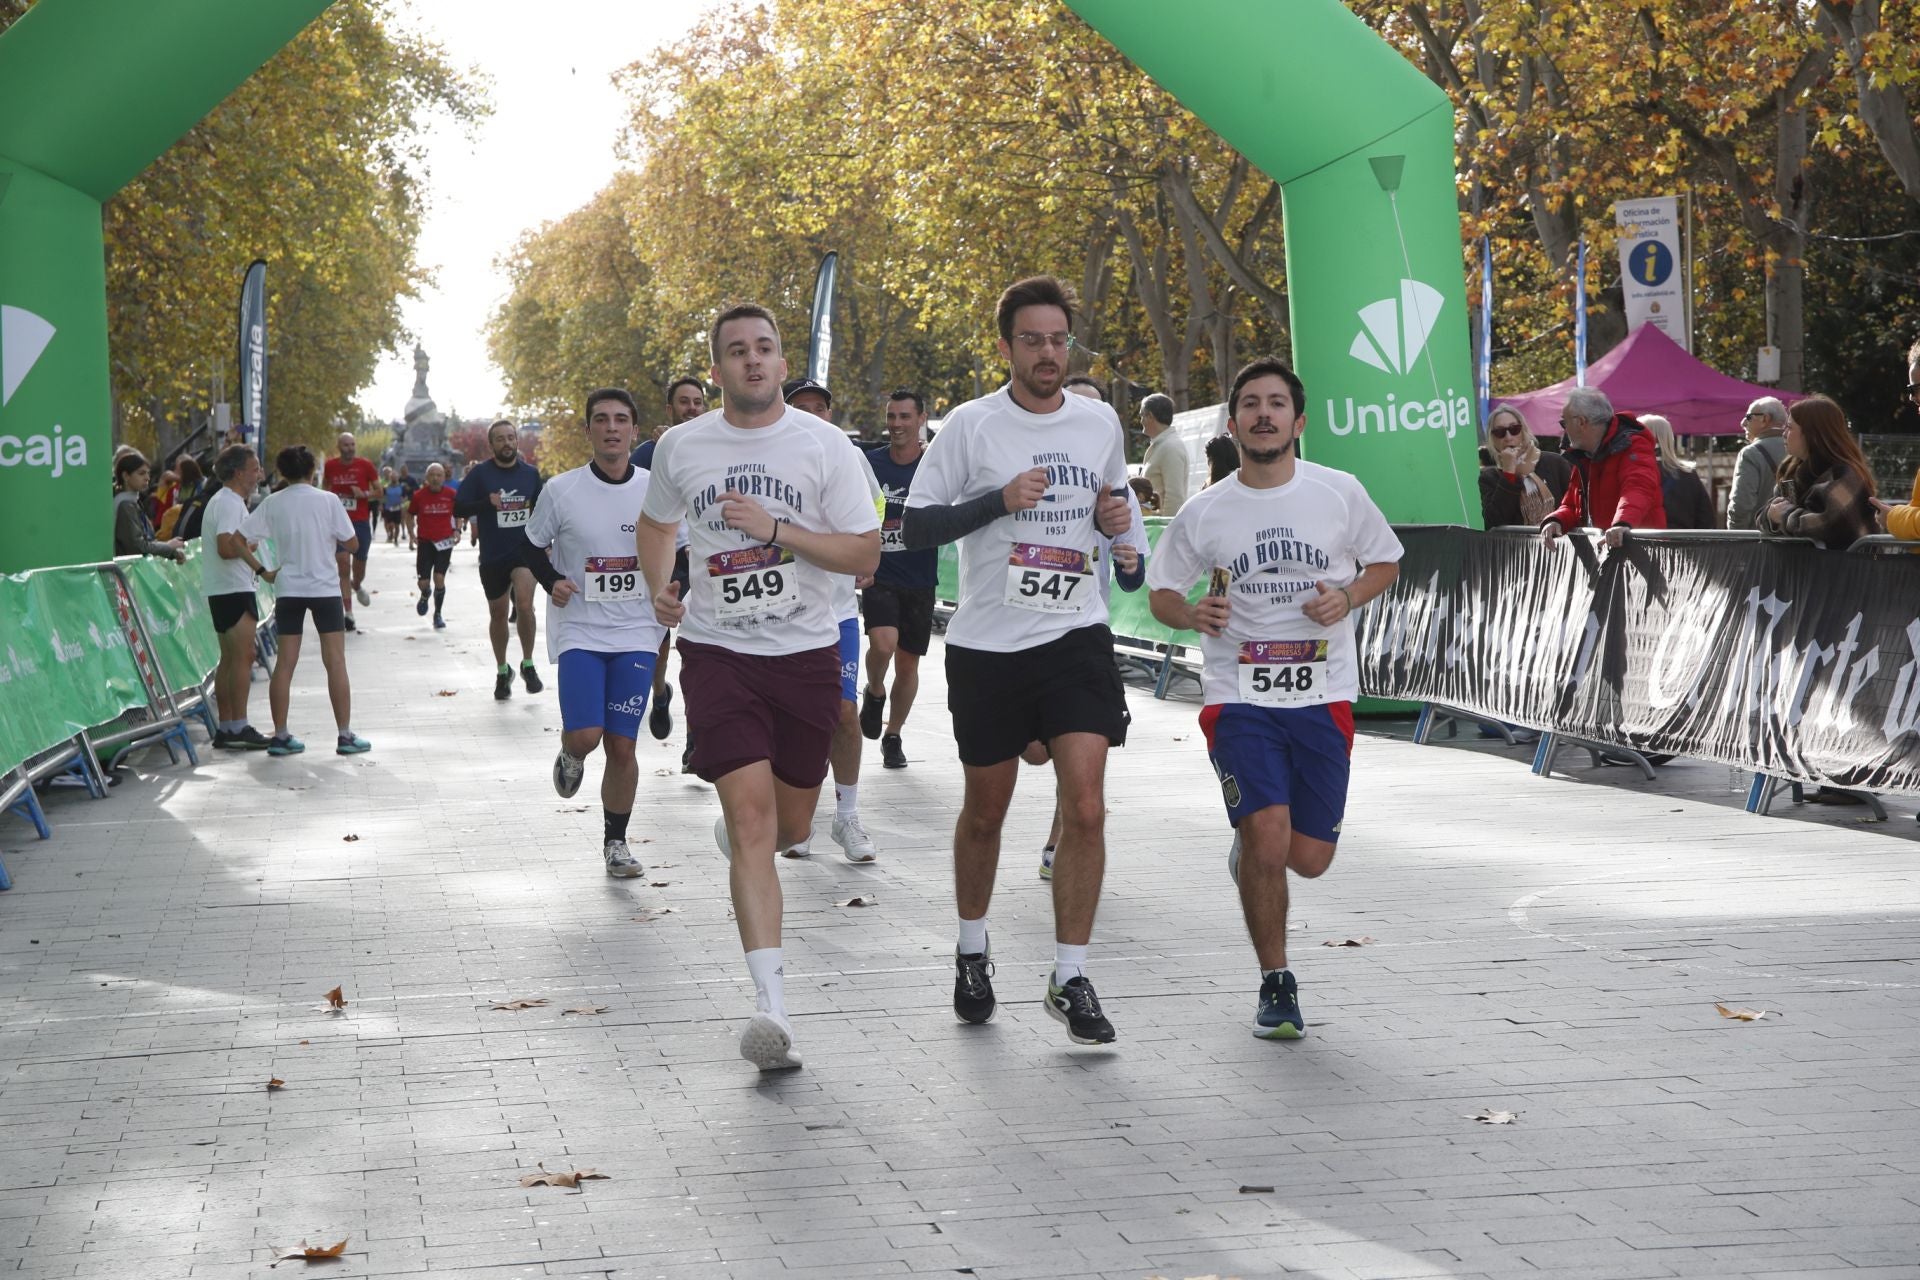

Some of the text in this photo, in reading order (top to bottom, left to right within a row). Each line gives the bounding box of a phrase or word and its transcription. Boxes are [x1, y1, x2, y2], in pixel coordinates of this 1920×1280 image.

[1623, 207, 1660, 217] Oficina de
[1327, 388, 1470, 439] Unicaja
[0, 424, 87, 478] caja
[1032, 452, 1071, 466] HOSPITAL
[727, 463, 766, 475] HOSPITAL
[1046, 464, 1102, 493] ORTEG
[694, 474, 802, 518] RIO HORTEGA
[502, 510, 526, 522] 732
[1045, 525, 1066, 536] 1953
[1255, 527, 1294, 542] HOSPITAL
[595, 574, 635, 592] 199
[722, 570, 784, 604] 549
[1019, 570, 1081, 601] 547
[1270, 595, 1292, 605] 1953
[1252, 665, 1313, 692] 548
[608, 700, 641, 717] cobra
